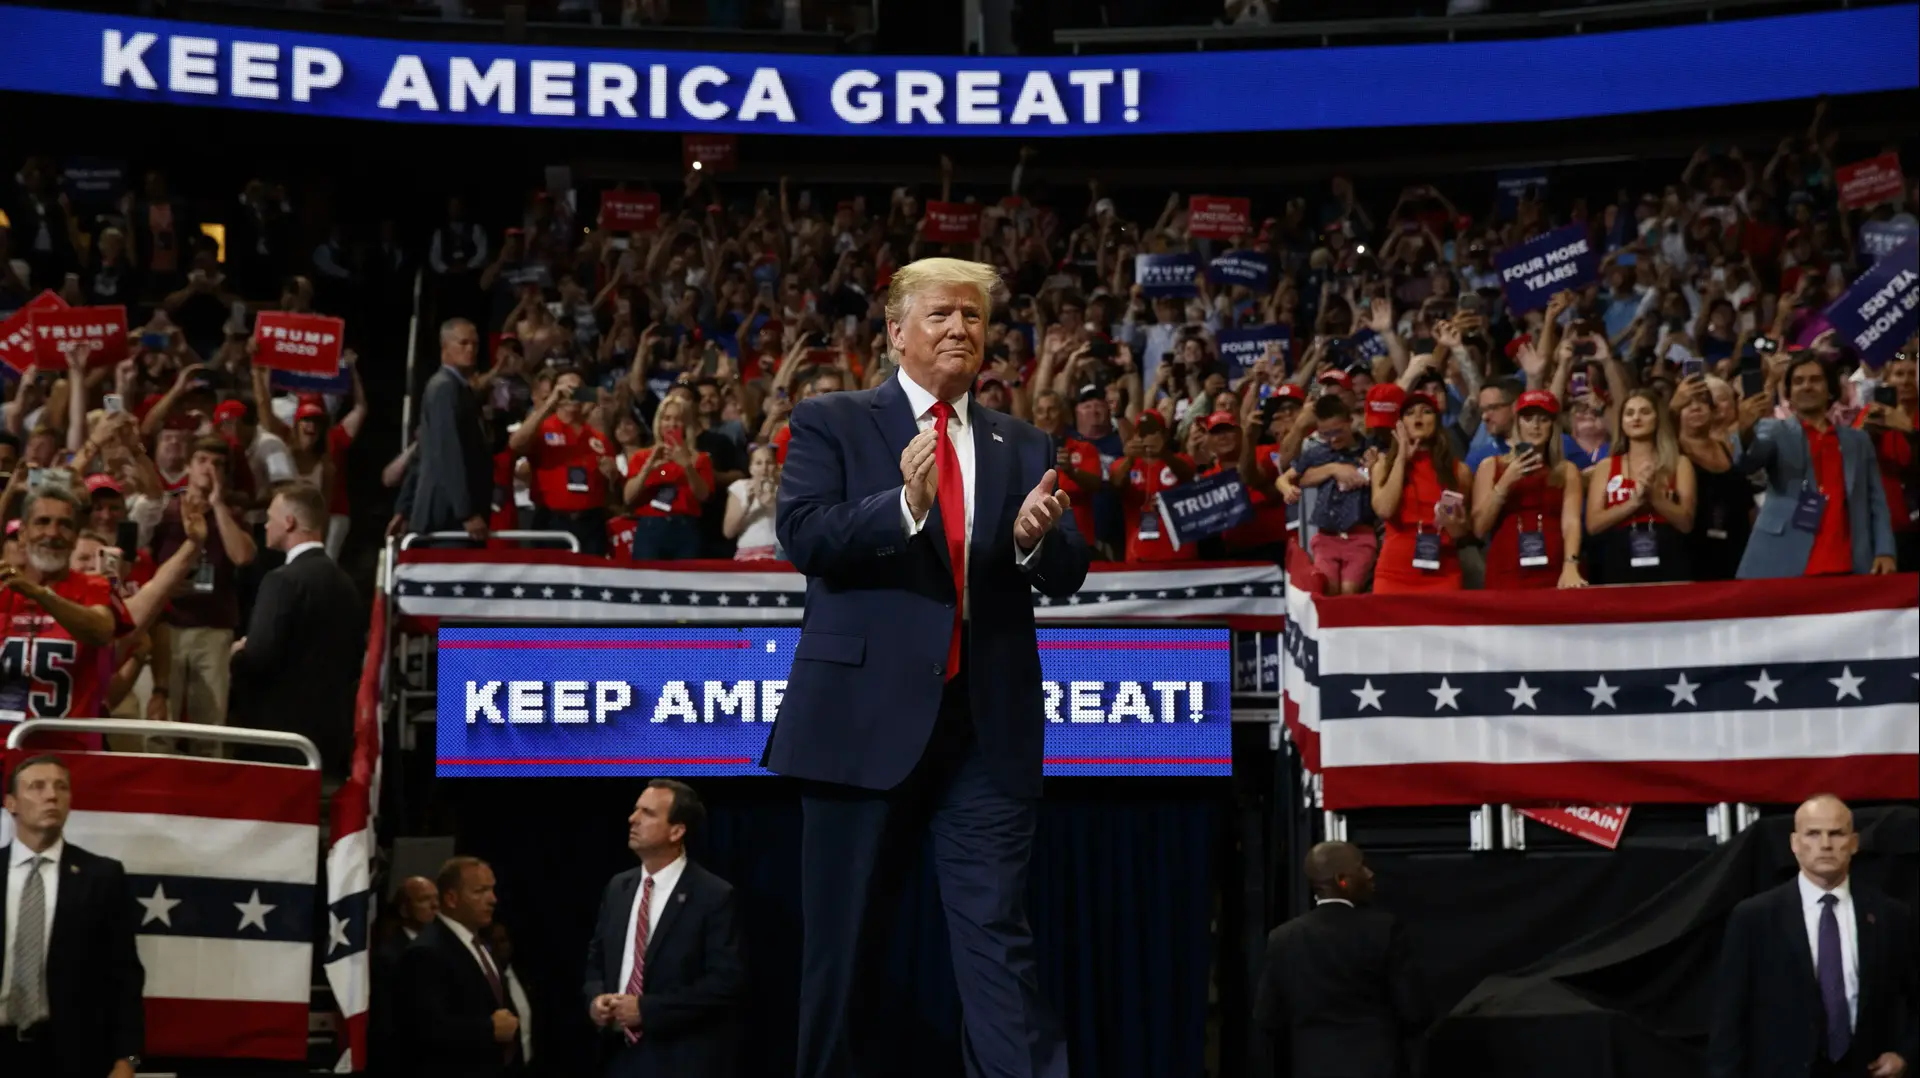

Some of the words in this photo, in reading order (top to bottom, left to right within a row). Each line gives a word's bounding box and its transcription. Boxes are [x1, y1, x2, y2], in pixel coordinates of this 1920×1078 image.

[102, 29, 343, 102] KEEP
[377, 55, 796, 122] AMERICA
[831, 69, 1140, 124] GREAT!
[1142, 264, 1196, 276] TRUMP
[1503, 257, 1546, 282] FOUR
[1545, 239, 1589, 265] MORE
[1524, 261, 1578, 291] YEARS!
[1858, 269, 1918, 321] YEARS!
[37, 323, 120, 339] TRUMP
[261, 325, 335, 345] TRUMP
[1854, 304, 1904, 351] MORE
[275, 340, 318, 356] 2020
[1220, 341, 1254, 354] FOUR
[1173, 482, 1240, 517] TRUMP
[465, 680, 632, 723] KEEP
[1042, 681, 1204, 724] REAT!
[1564, 806, 1620, 832] AGAIN
